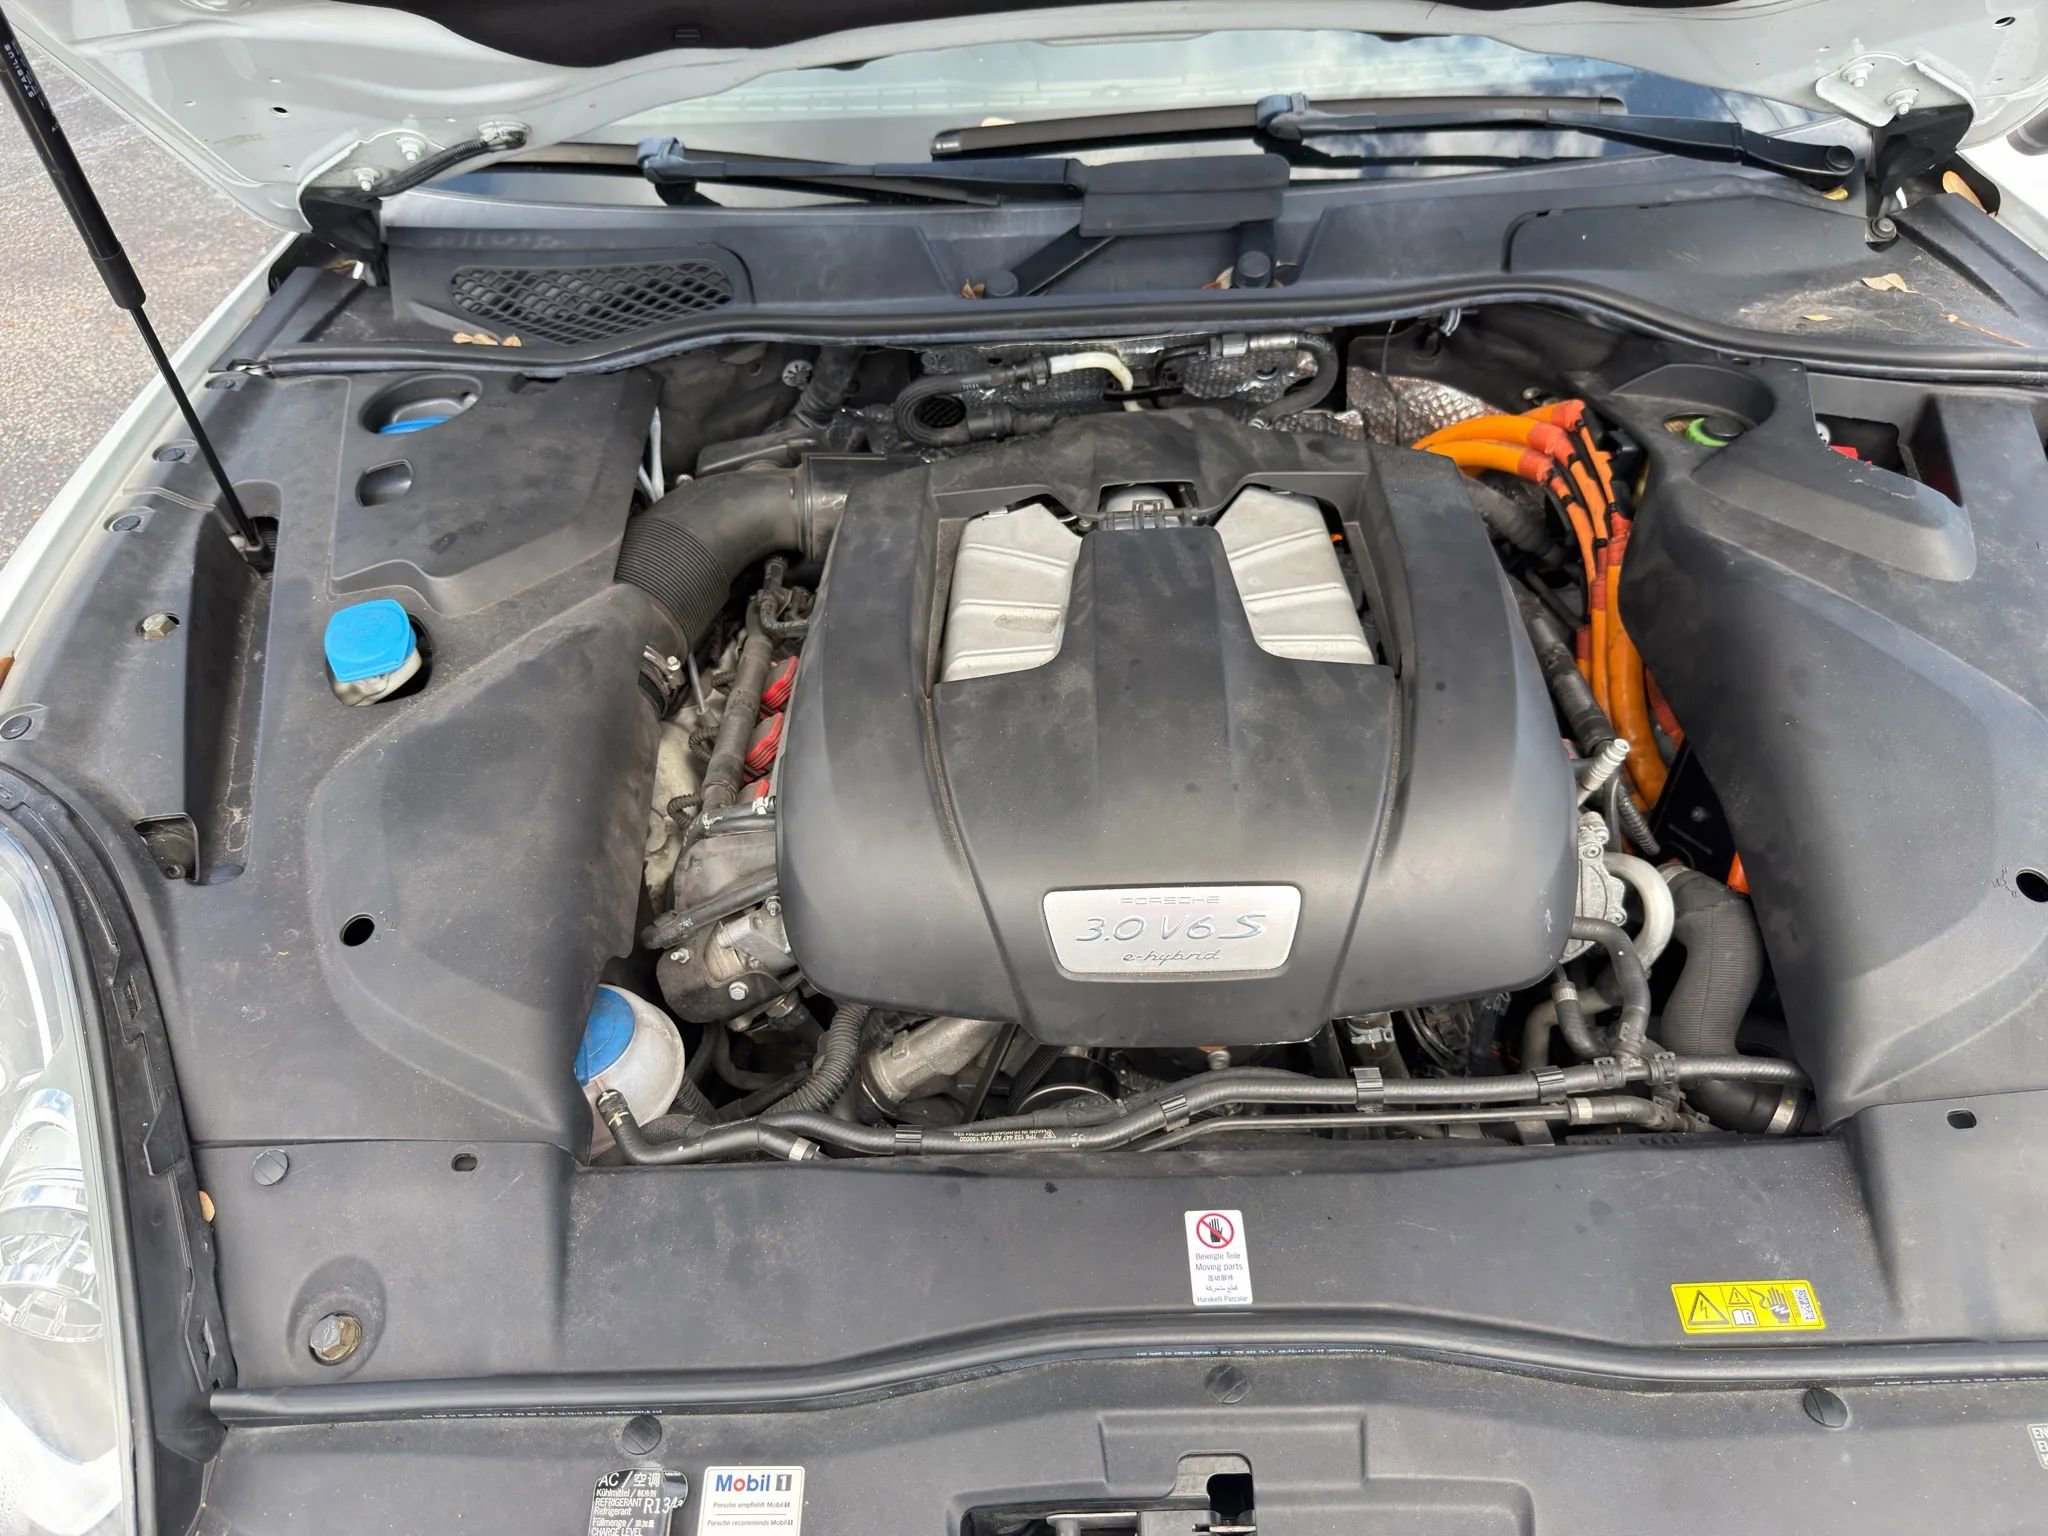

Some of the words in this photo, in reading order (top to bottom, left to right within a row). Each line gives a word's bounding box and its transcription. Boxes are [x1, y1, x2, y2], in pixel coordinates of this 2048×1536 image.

[4, 43, 35, 98] STABILUS
[1120, 895, 1220, 905] PORSCHE
[1075, 916, 1146, 942] 3.0
[1160, 914, 1215, 940] V6
[1217, 914, 1267, 940] S
[1122, 949, 1221, 966] e-hybrid
[1195, 1252, 1224, 1260] Bewegte
[1195, 1263, 1221, 1272] Moving
[1223, 1263, 1243, 1271] parts
[598, 1472, 620, 1487] AC
[633, 1472, 661, 1488] 空调
[715, 1473, 771, 1492] Mobil
[777, 1474, 791, 1491] 1
[595, 1497, 643, 1507] REFRIGERANT
[594, 1506, 632, 1517] Refrigerant
[591, 1528, 621, 1536] CHARGE
[621, 1528, 643, 1536] LEVEL
